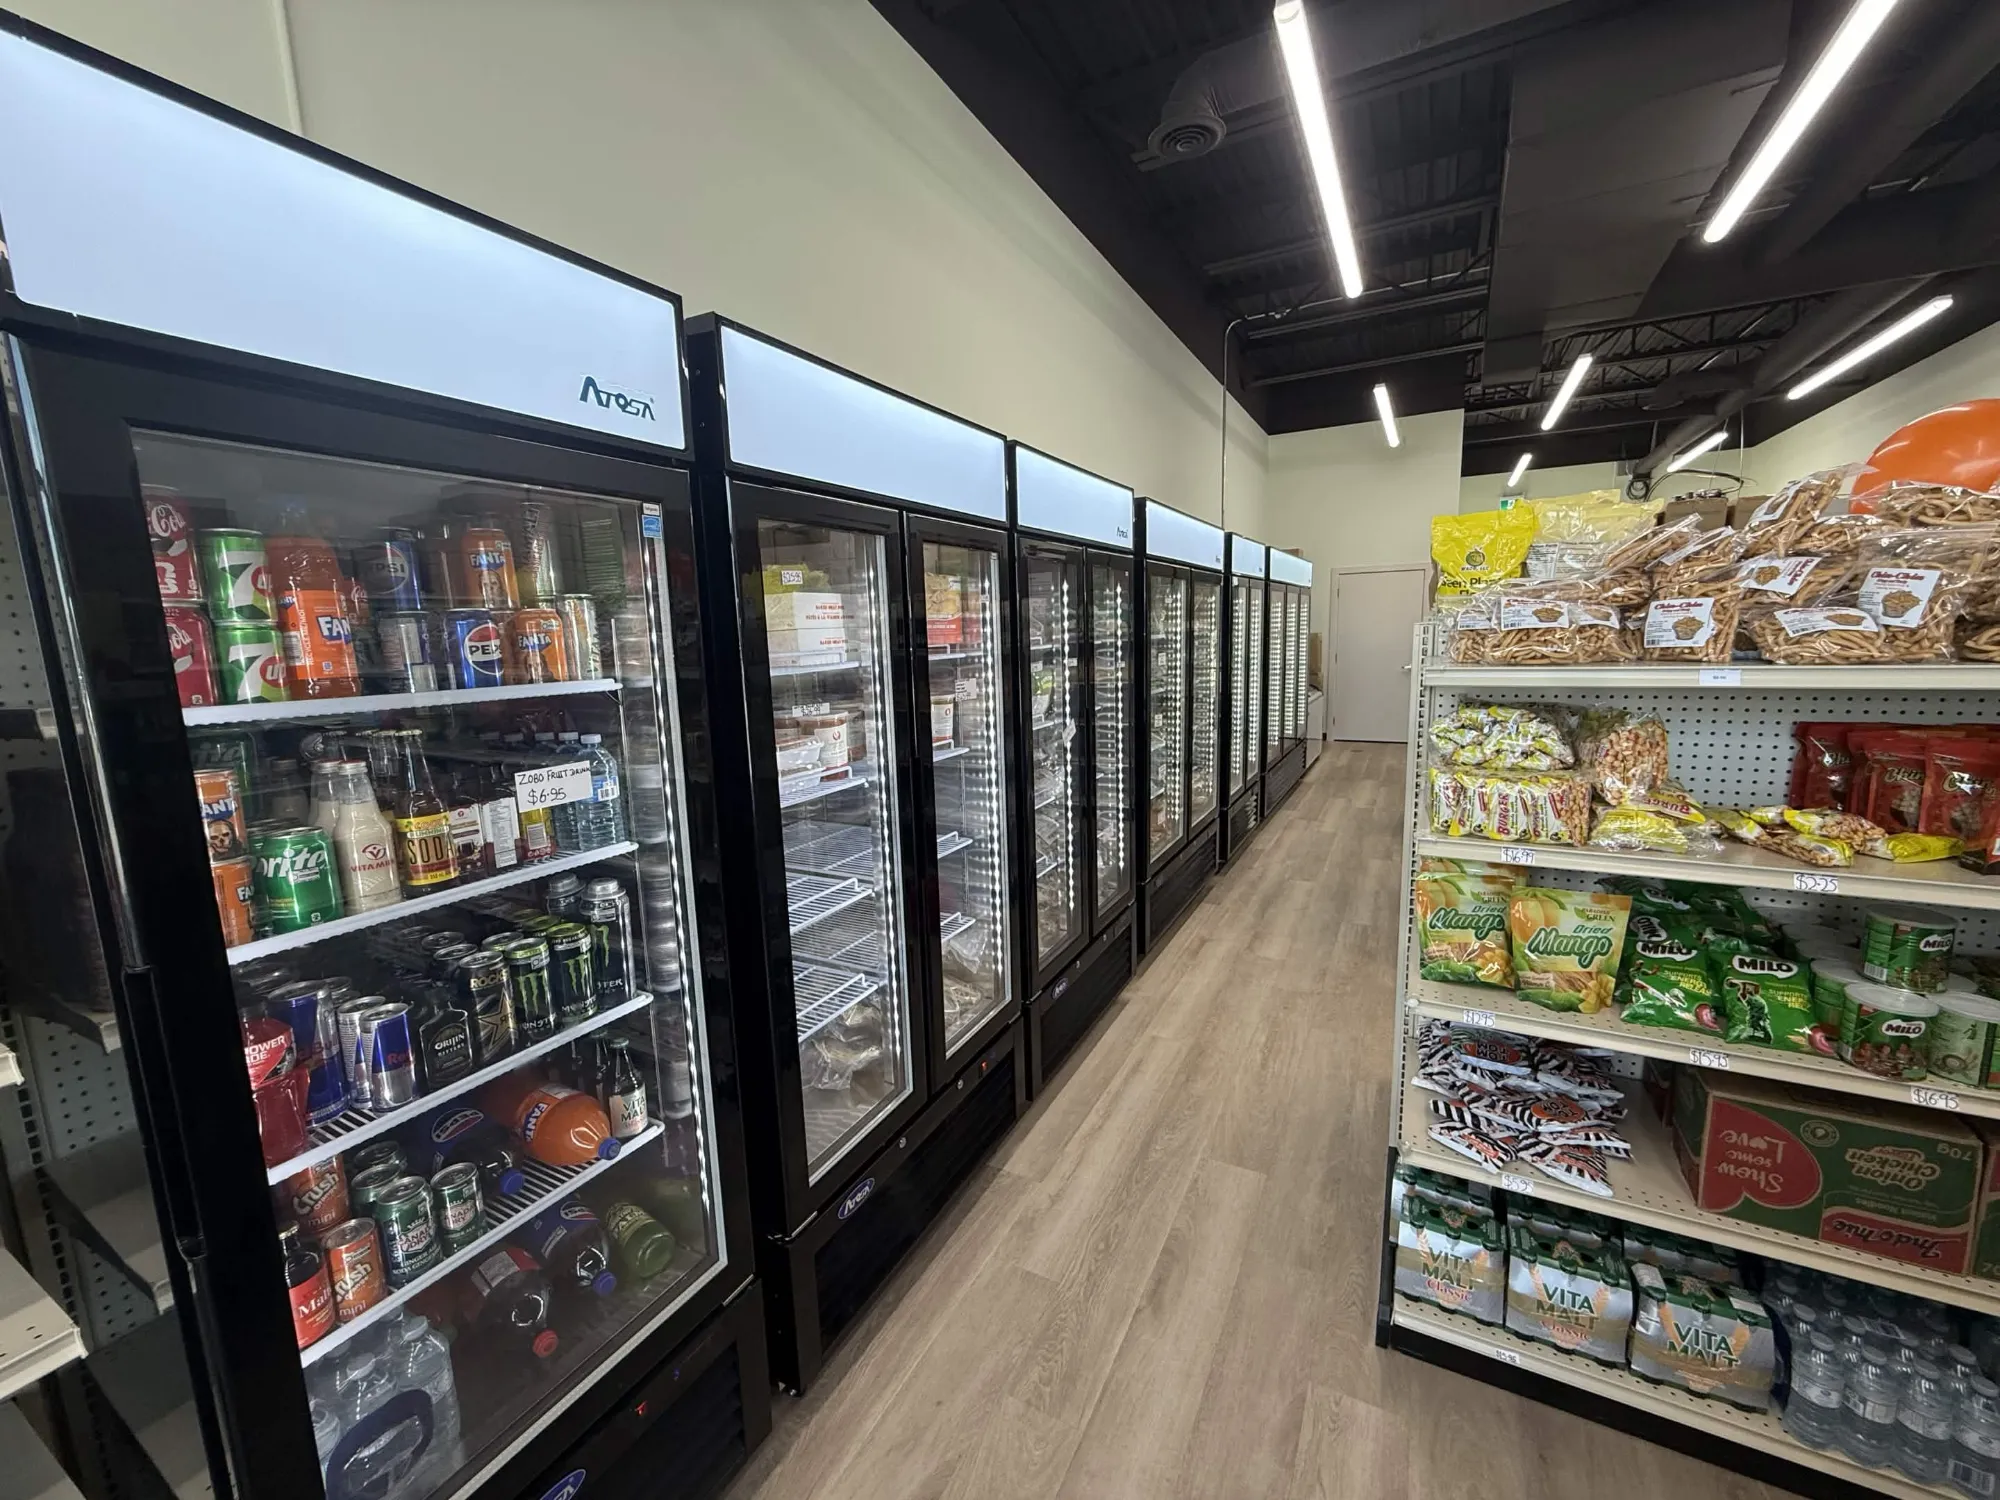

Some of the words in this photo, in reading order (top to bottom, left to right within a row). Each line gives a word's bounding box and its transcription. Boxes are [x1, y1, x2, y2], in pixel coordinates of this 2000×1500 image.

[470, 552, 506, 567] FANTA
[518, 632, 552, 647] FANTA
[517, 774, 544, 785] ZOBO
[547, 769, 569, 780] FRUIT
[527, 787, 567, 806] $6.95
[1496, 792, 1510, 836] BURGER
[1503, 848, 1534, 863] $16.99
[1796, 873, 1838, 893] $2.25
[1471, 905, 1507, 914] Dried
[1586, 914, 1616, 922] GREEN
[1430, 908, 1504, 940] Mango
[1572, 925, 1613, 935] Dried
[1529, 929, 1612, 967] Mango
[1738, 957, 1794, 974] MILO
[1884, 1023, 1923, 1036] MILO
[434, 1033, 465, 1050] ORIJIN
[1691, 1049, 1730, 1069] $15.95
[1725, 1150, 1774, 1168] some
[1936, 1143, 1973, 1161] 70g
[1846, 1149, 1940, 1178] Chicken
[1717, 1162, 1784, 1193] Show
[1853, 1162, 1926, 1190] Onion
[293, 1172, 339, 1215] Crush
[308, 1210, 336, 1227] mini
[1429, 1246, 1475, 1272] VITA
[1421, 1262, 1476, 1291] MALT
[1426, 1278, 1473, 1302] Classic
[1542, 1282, 1595, 1315] VITA
[339, 1299, 367, 1317] mini
[1536, 1298, 1600, 1331] MALT
[1673, 1320, 1736, 1355] VITA
[1667, 1341, 1740, 1369] MALT
